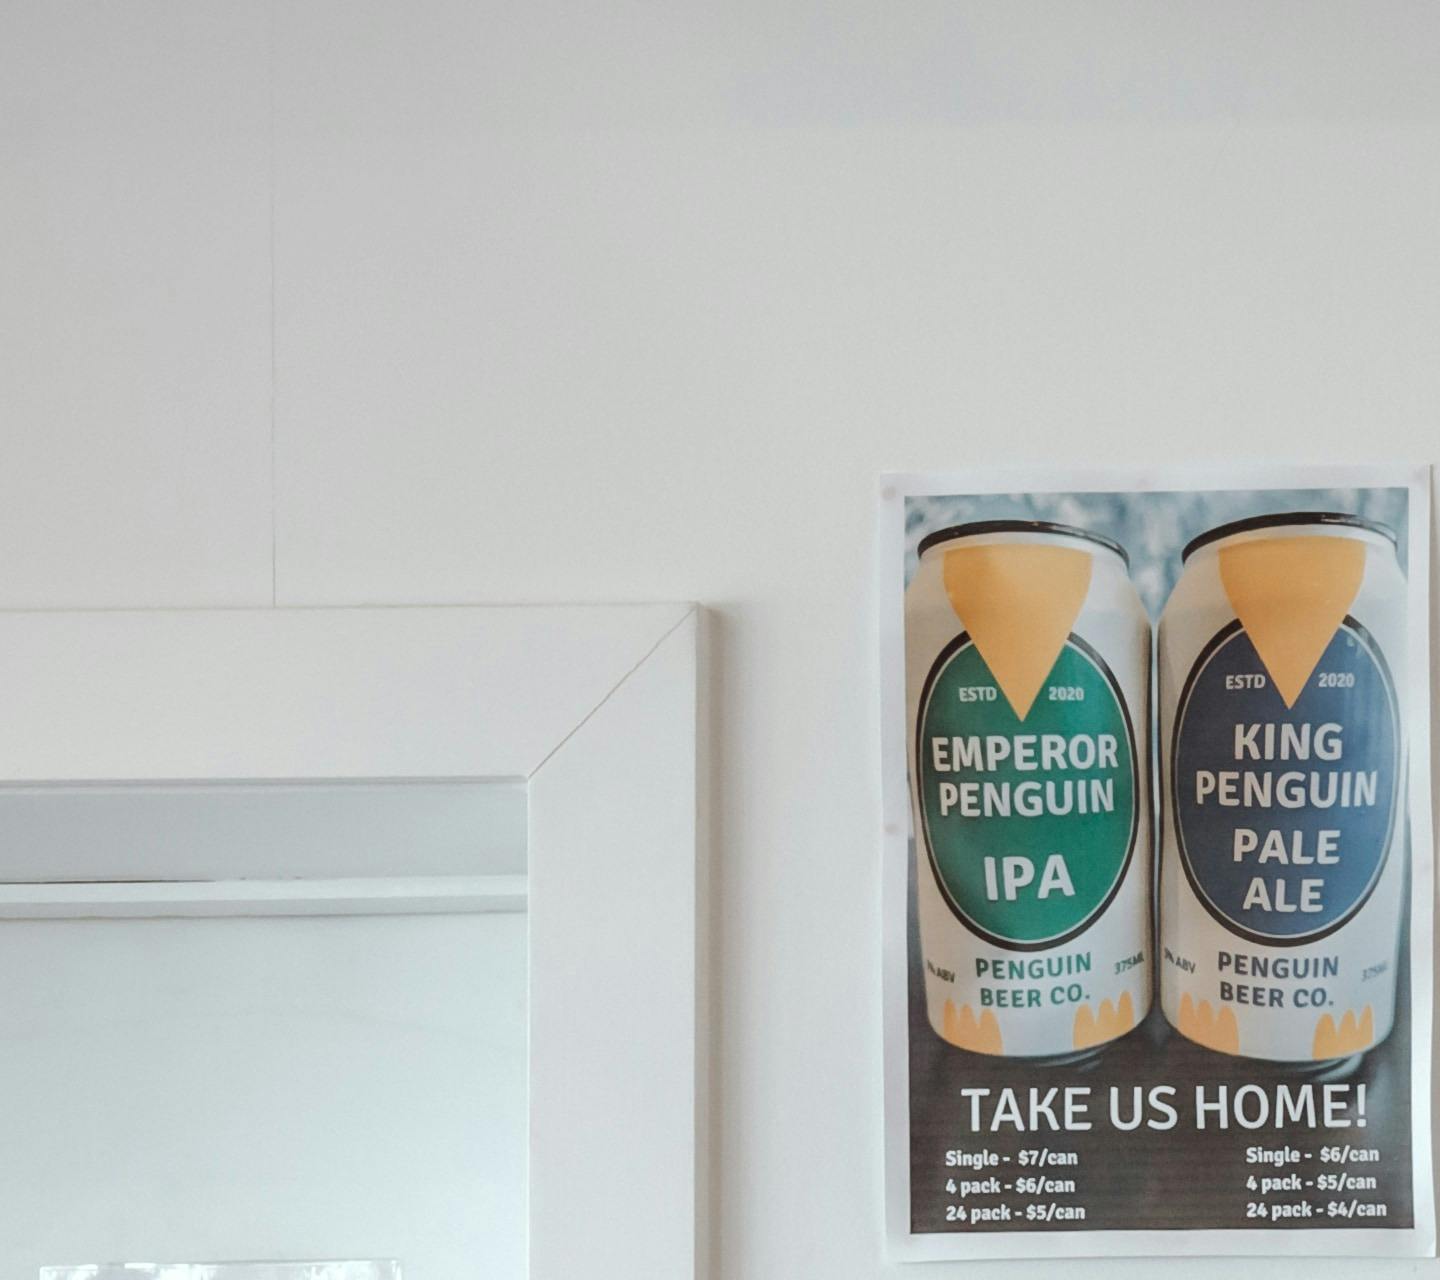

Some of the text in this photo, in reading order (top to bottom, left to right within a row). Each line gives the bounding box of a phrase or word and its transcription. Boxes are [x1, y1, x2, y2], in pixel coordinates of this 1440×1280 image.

[959, 686, 1084, 702] ESTD 2020
[931, 734, 1119, 772] EMPEROR
[1234, 723, 1343, 760] KING
[939, 778, 1114, 817] PENGUIN
[1196, 770, 1377, 808] PENGUIN
[1233, 828, 1340, 866] PALE
[984, 854, 1075, 901] IPA
[1243, 876, 1324, 914] ALE
[975, 952, 1092, 980] PENGUIN
[980, 983, 1091, 1008] BEER CO.
[961, 1083, 1367, 1132] TAKE US HOME!
[946, 1149, 1078, 1168] Single $7/can
[1246, 1146, 1379, 1165] Single $6/can
[946, 1205, 967, 1221] 24
[971, 1204, 1011, 1223] pack
